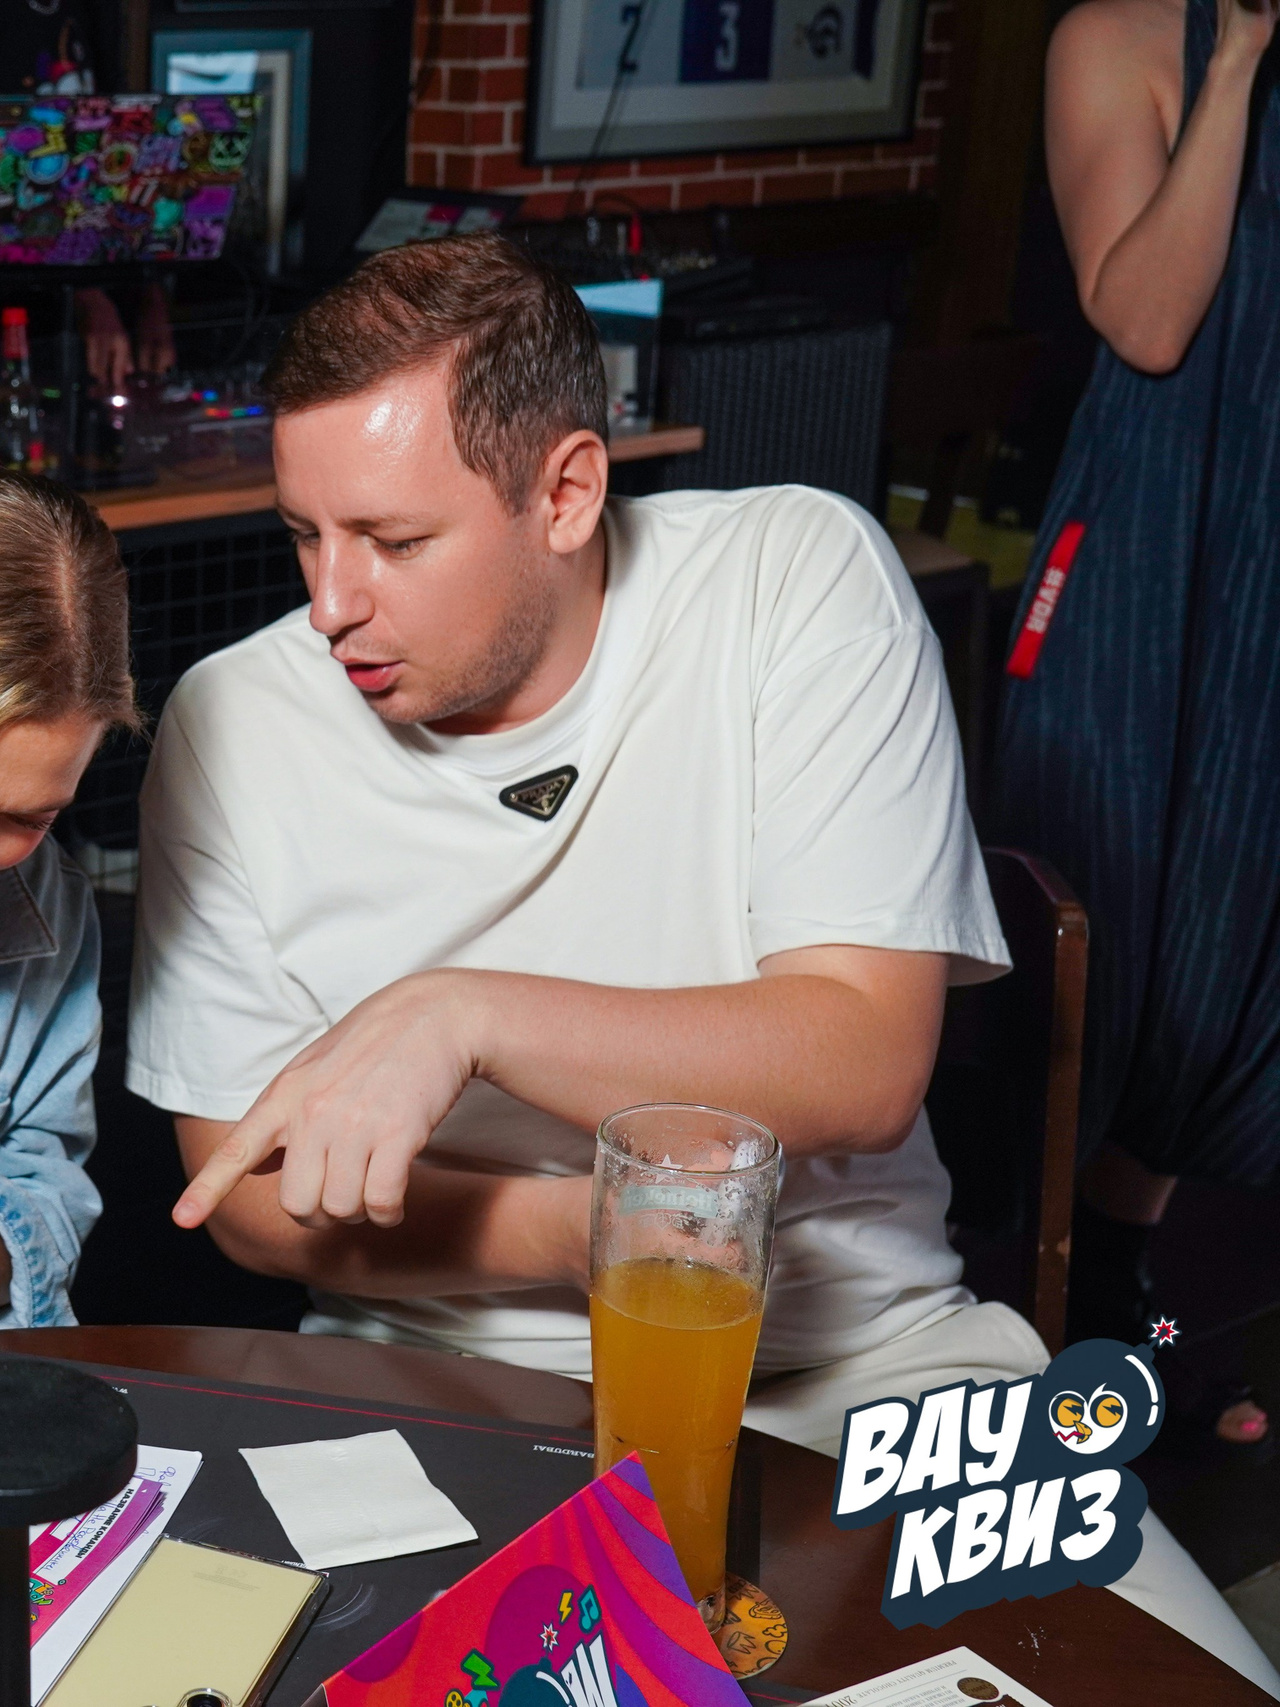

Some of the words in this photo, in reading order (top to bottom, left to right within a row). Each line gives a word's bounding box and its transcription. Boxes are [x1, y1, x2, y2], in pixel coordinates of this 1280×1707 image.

[713, 2, 741, 72] 3
[102, 1488, 133, 1527] НАЗВАНИЕ
[74, 1526, 106, 1558] КОМАНДЫ
[896, 1669, 925, 1682] QUALITY
[924, 1659, 956, 1673] PREMIUM
[855, 1680, 896, 1698] CHOCOLATE
